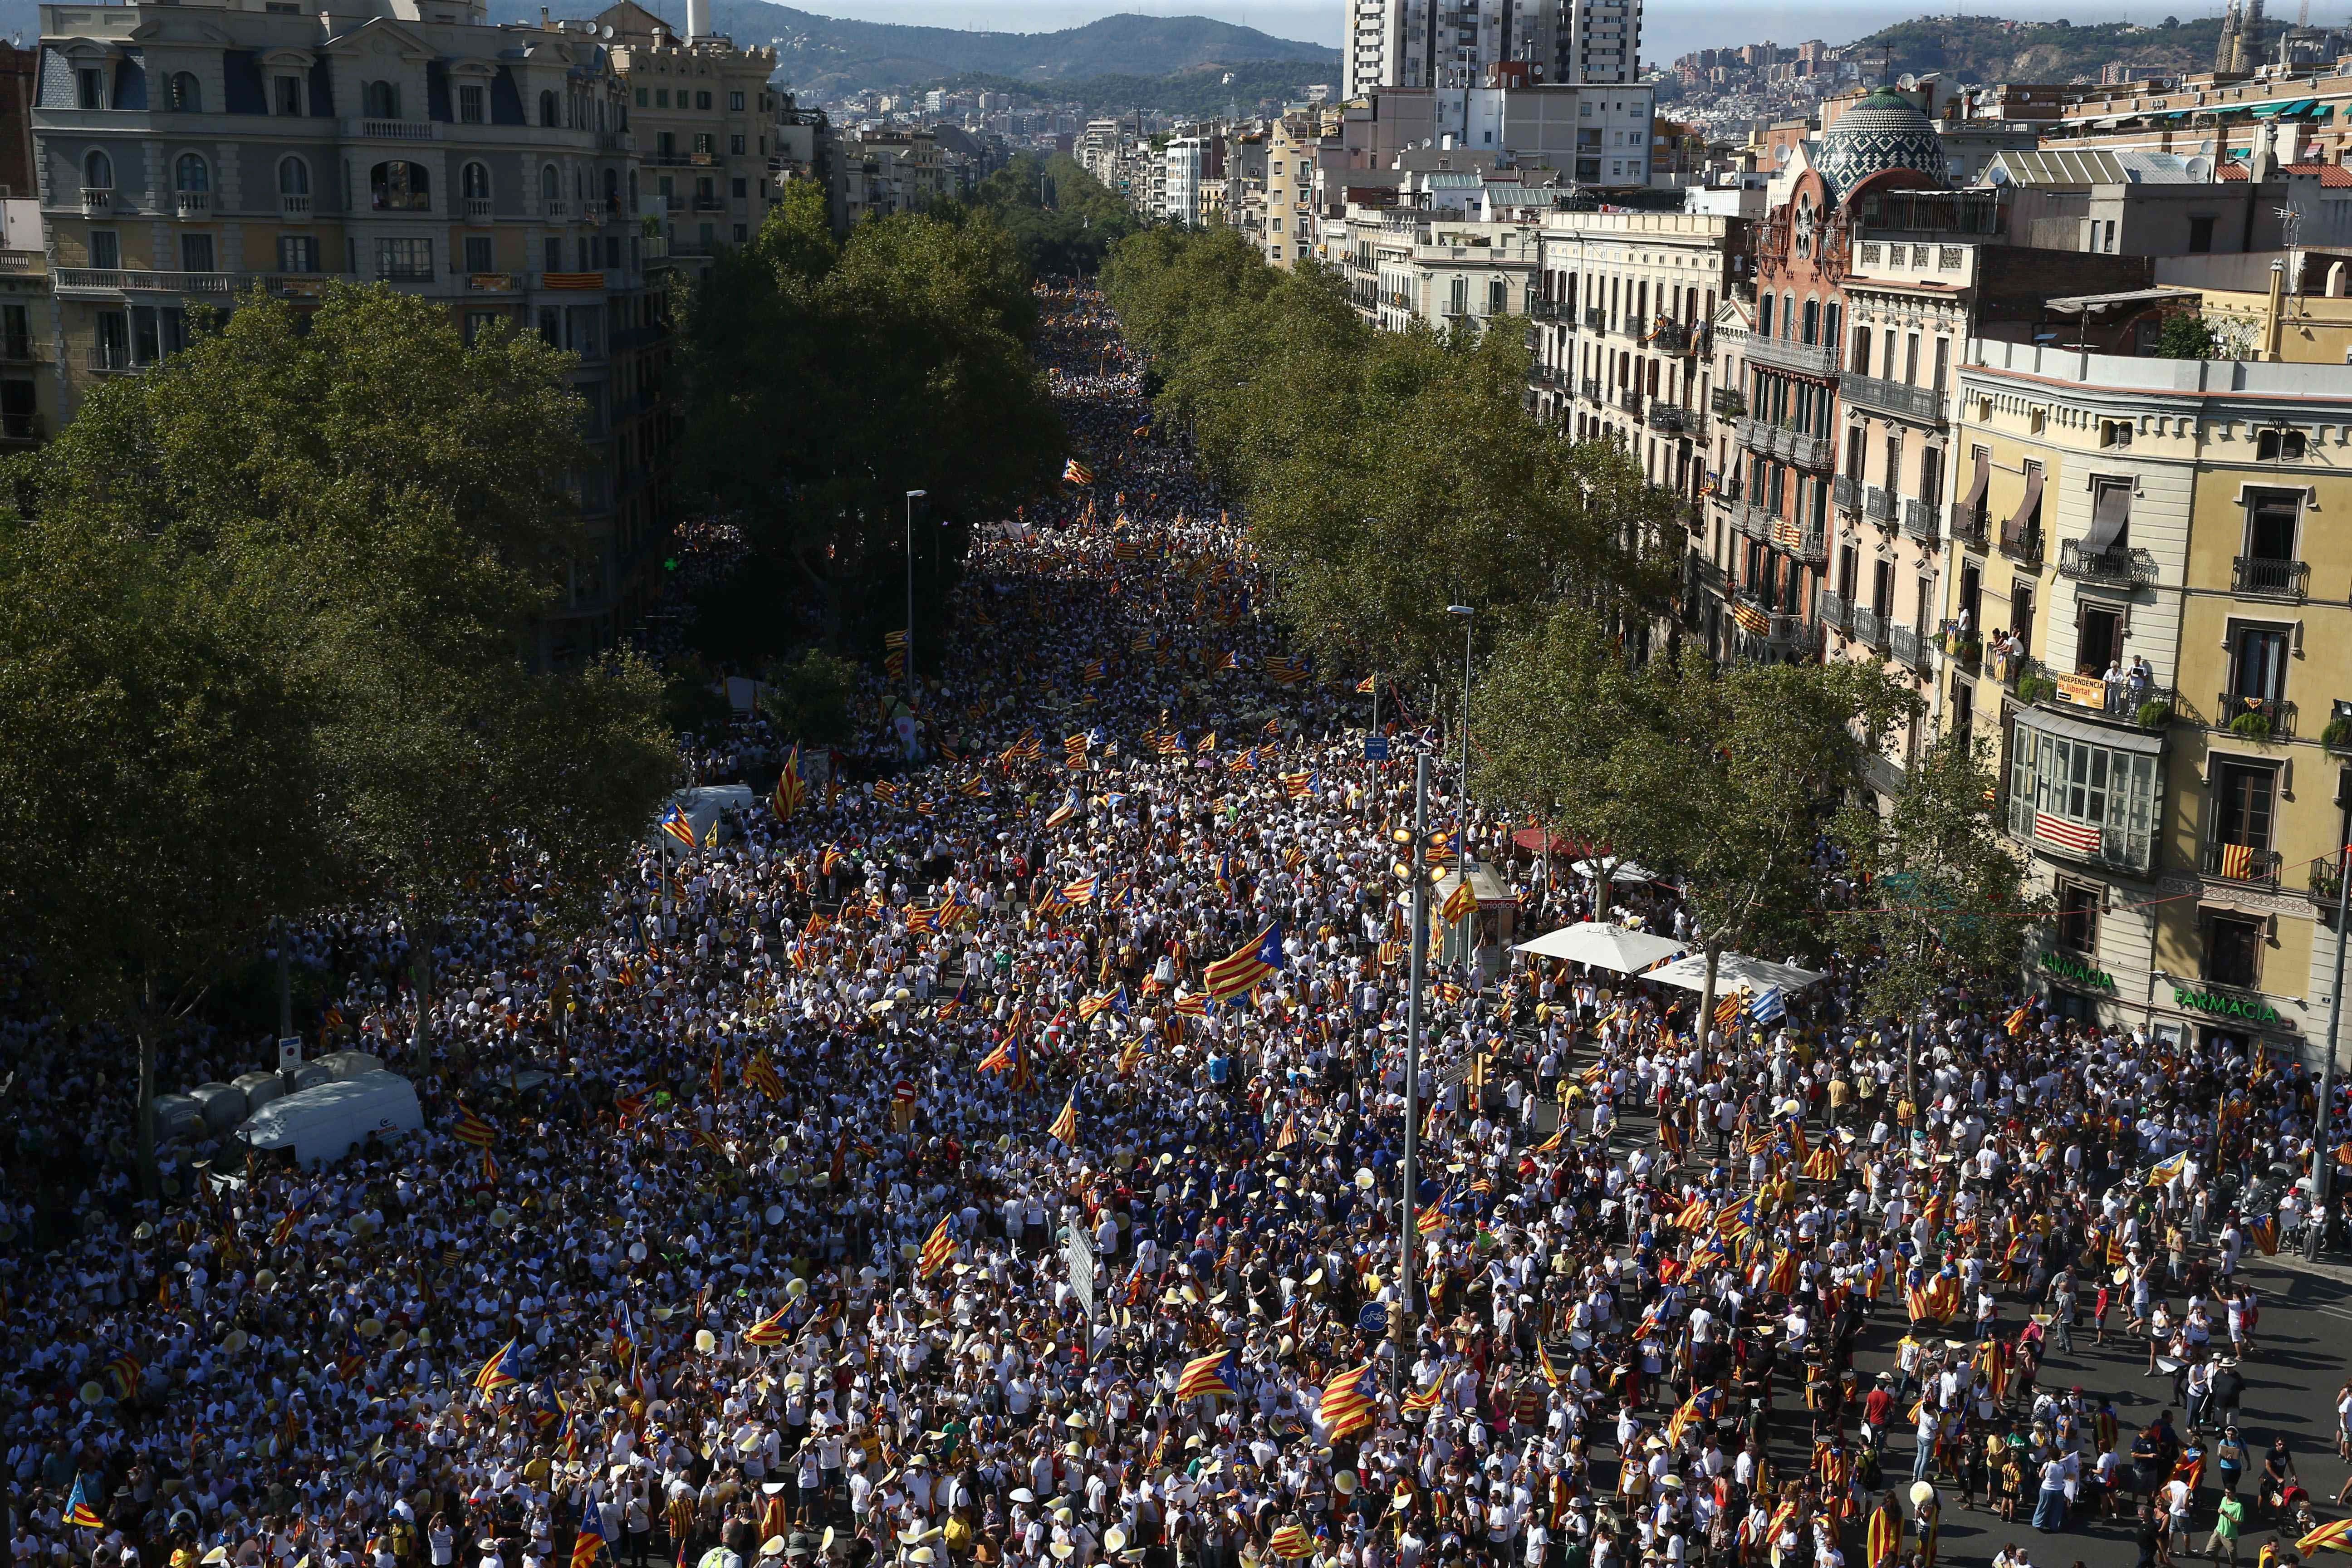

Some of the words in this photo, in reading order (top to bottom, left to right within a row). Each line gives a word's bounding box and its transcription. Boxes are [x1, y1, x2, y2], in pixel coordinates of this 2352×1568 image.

[2058, 681, 2064, 690] és
[2066, 683, 2090, 696] llibertat
[2059, 675, 2104, 689] INDEPENDÈNCIA
[1477, 901, 1515, 909] Periódico
[2040, 951, 2112, 990] FARMACIA
[2174, 987, 2276, 1024] FARMACIA
